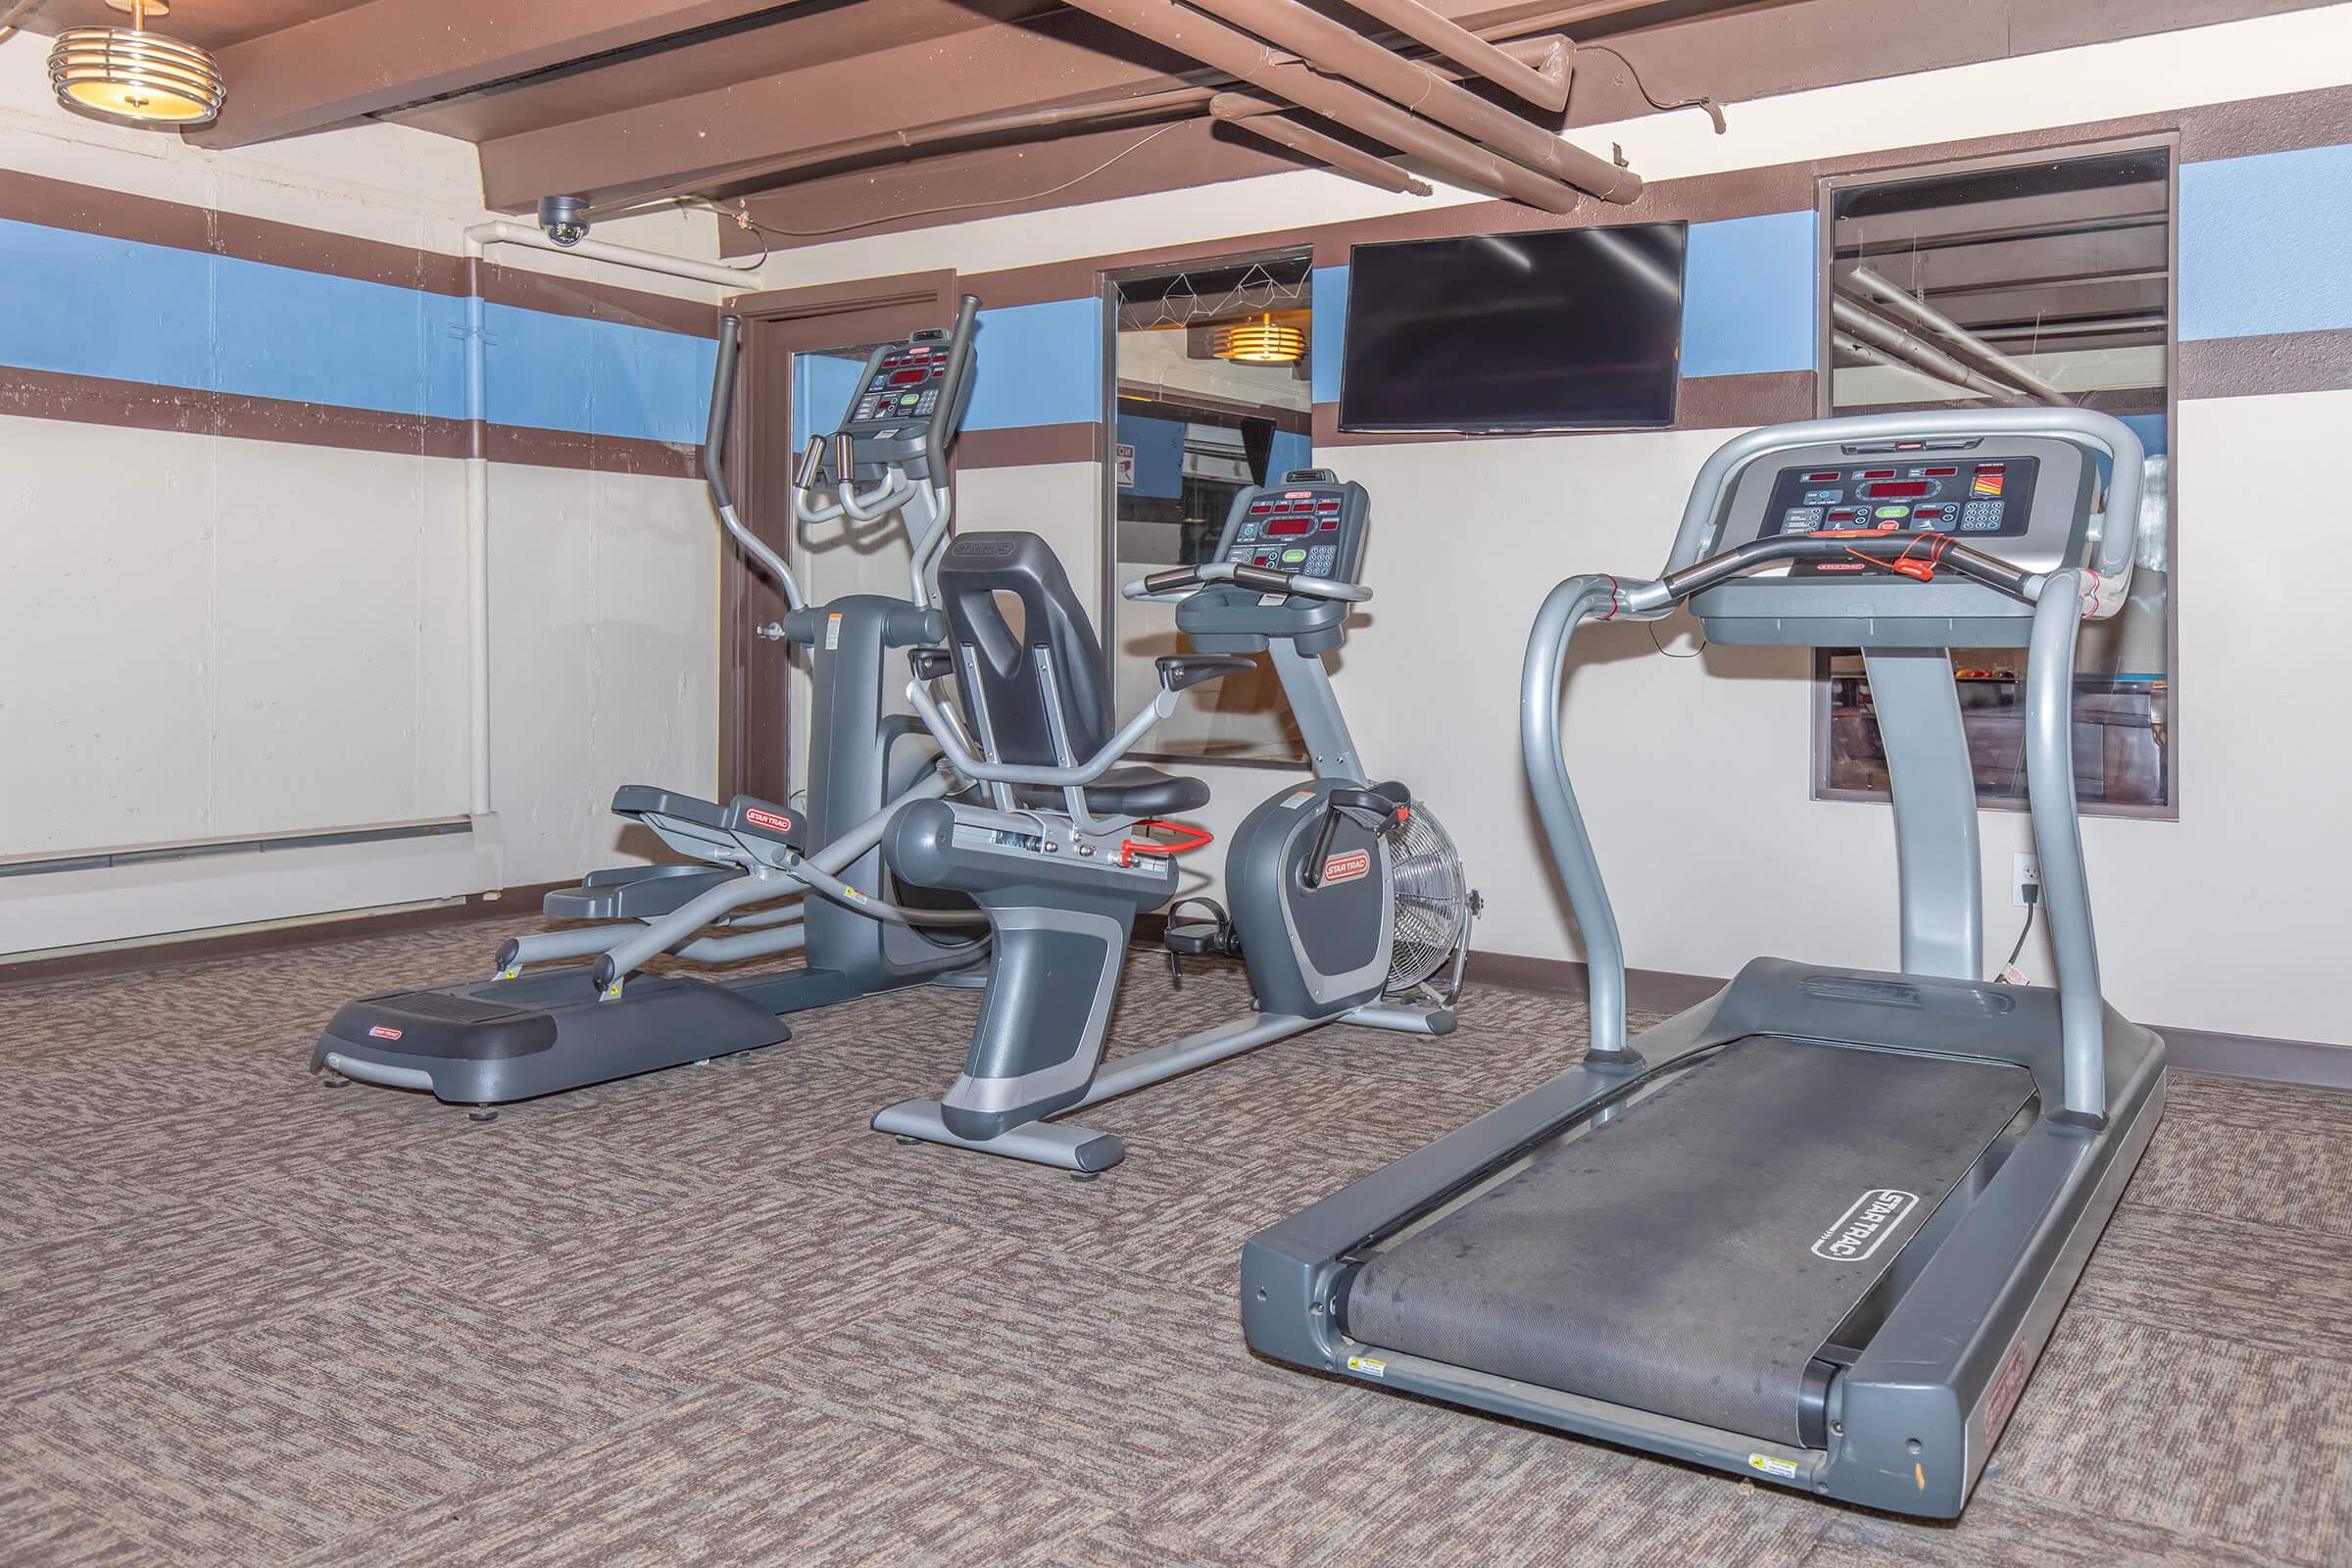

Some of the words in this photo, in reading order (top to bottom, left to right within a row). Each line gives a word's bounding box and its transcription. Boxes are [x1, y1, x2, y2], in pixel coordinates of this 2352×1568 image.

[749, 811, 768, 823] STAR
[767, 816, 788, 828] TRAC
[1327, 863, 1347, 875] STAR
[1347, 858, 1365, 870] TRAC
[1859, 1191, 1905, 1223] STAR
[1829, 1222, 1880, 1255] TRAC
